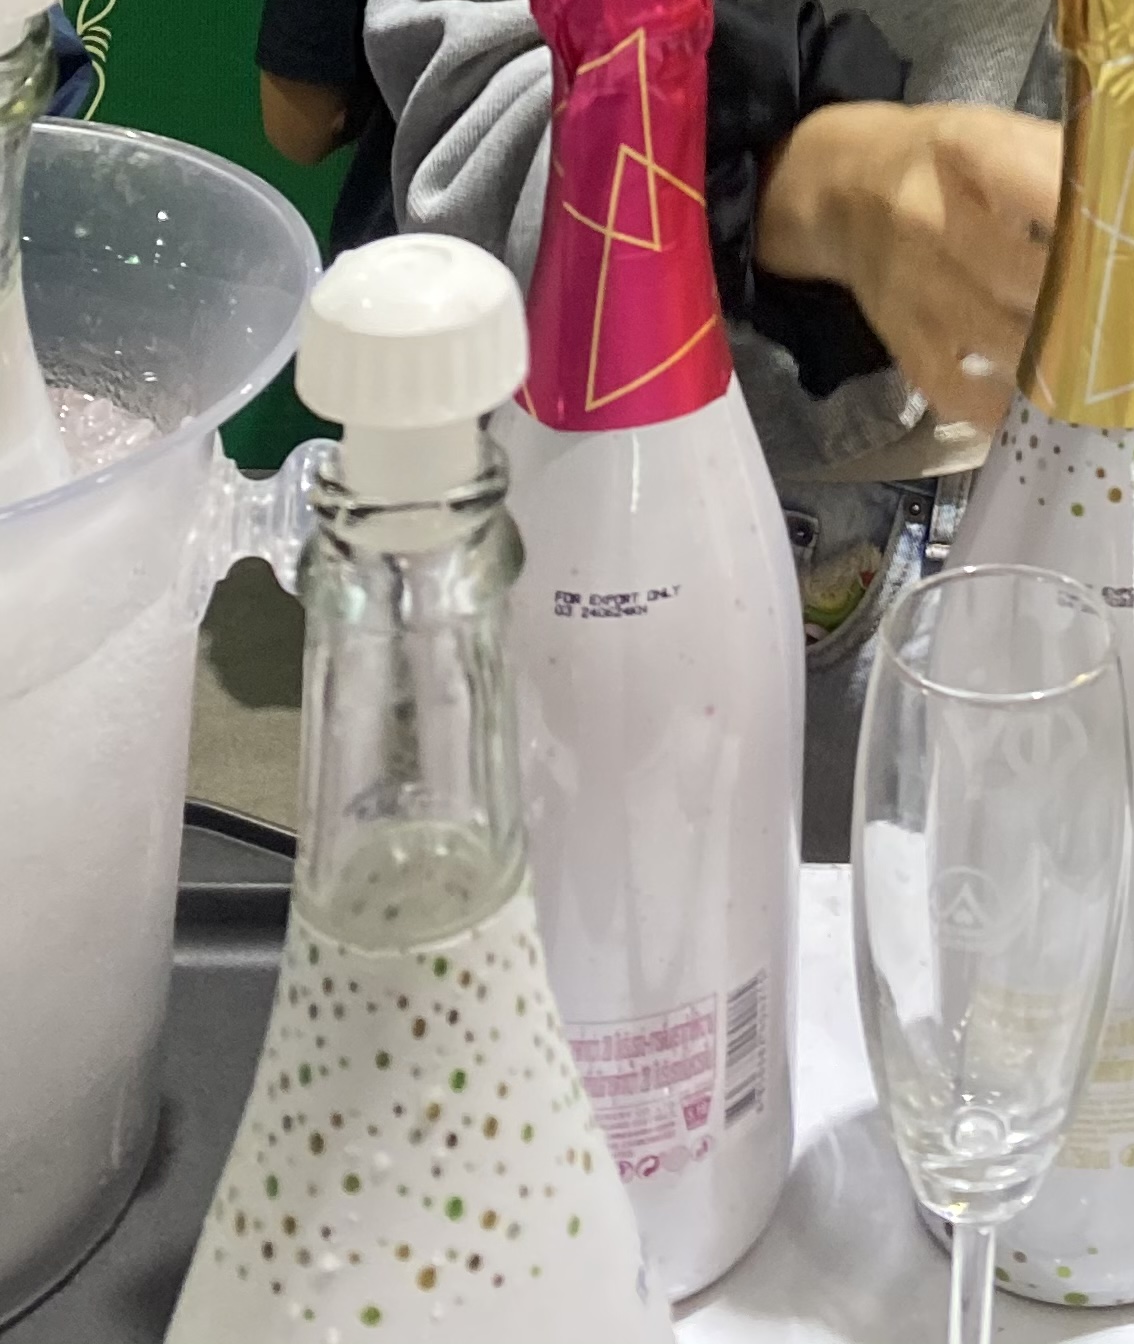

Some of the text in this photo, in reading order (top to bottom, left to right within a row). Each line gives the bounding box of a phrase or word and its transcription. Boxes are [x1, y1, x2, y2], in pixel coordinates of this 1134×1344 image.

[555, 585, 680, 605] FOR EXPORT ONLY
